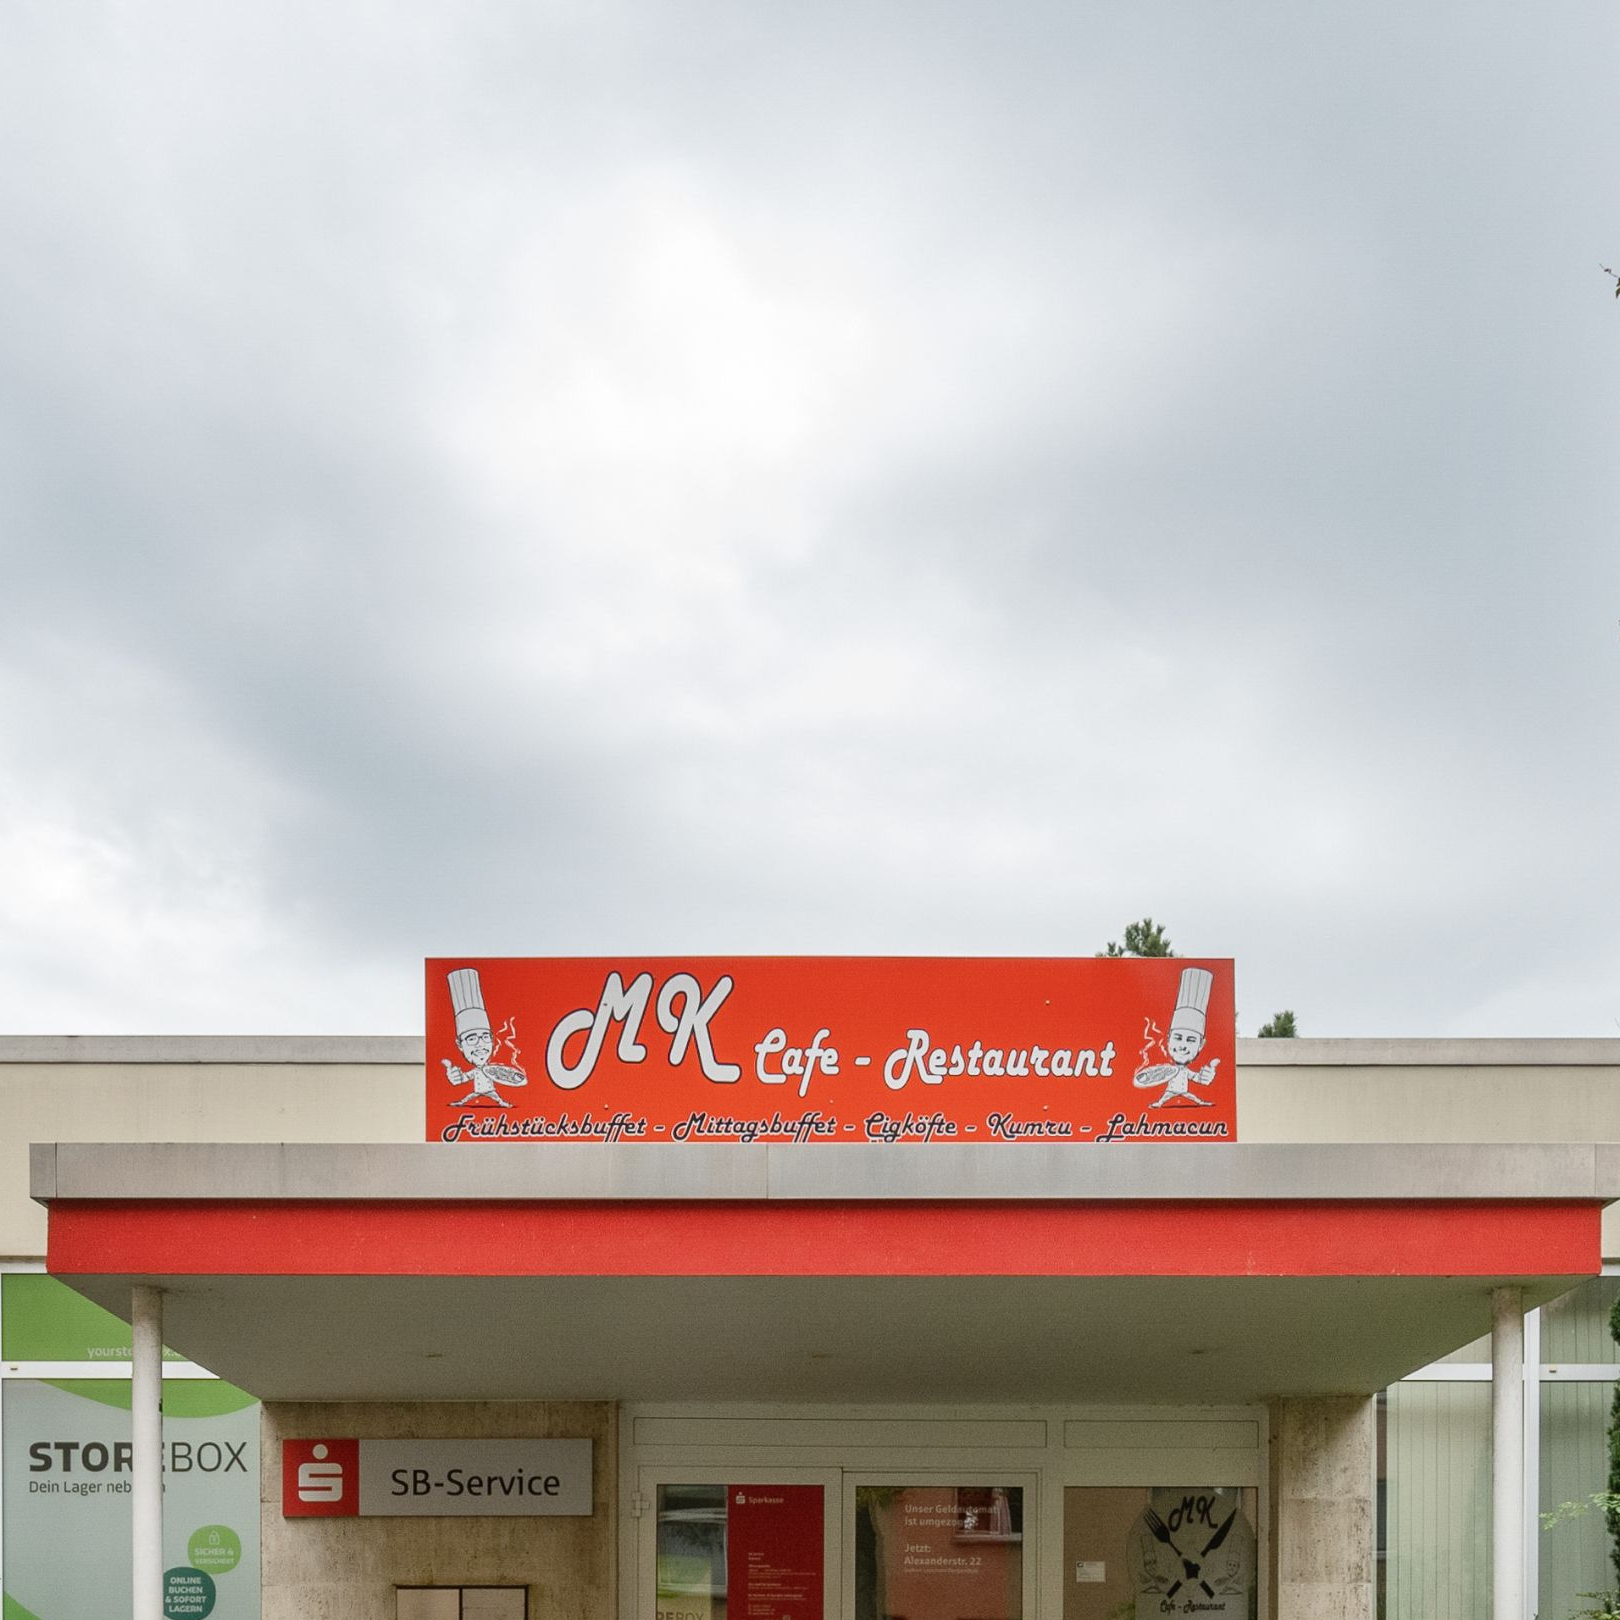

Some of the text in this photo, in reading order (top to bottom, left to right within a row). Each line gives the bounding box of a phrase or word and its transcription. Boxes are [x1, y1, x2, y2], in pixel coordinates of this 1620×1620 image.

[545, 971, 742, 1090] MK
[754, 1028, 840, 1098] Cafe
[884, 1028, 1116, 1091] Restaurant
[441, 1112, 647, 1143] Frühstücksbuffet
[671, 1112, 838, 1143] Mittagsbuffet
[987, 1112, 1072, 1141] Kumru
[1095, 1112, 1228, 1143] Lahmacun
[29, 1441, 248, 1472] STORBOX
[391, 1468, 561, 1497] SB-Service
[29, 1480, 60, 1493] Dein
[63, 1480, 103, 1496] Lager
[748, 1496, 784, 1504] Sparkasse
[905, 1504, 932, 1513] Unser
[1168, 1495, 1218, 1532] MK
[194, 1547, 225, 1556] SICHER
[905, 1544, 931, 1553] Jetzt:
[904, 1556, 982, 1566] Alexanderstr. 22
[170, 1577, 201, 1585] ONLINE
[168, 1586, 203, 1594] BUCHEN
[173, 1596, 207, 1604] SOFORT
[169, 1605, 203, 1613] LAGERN
